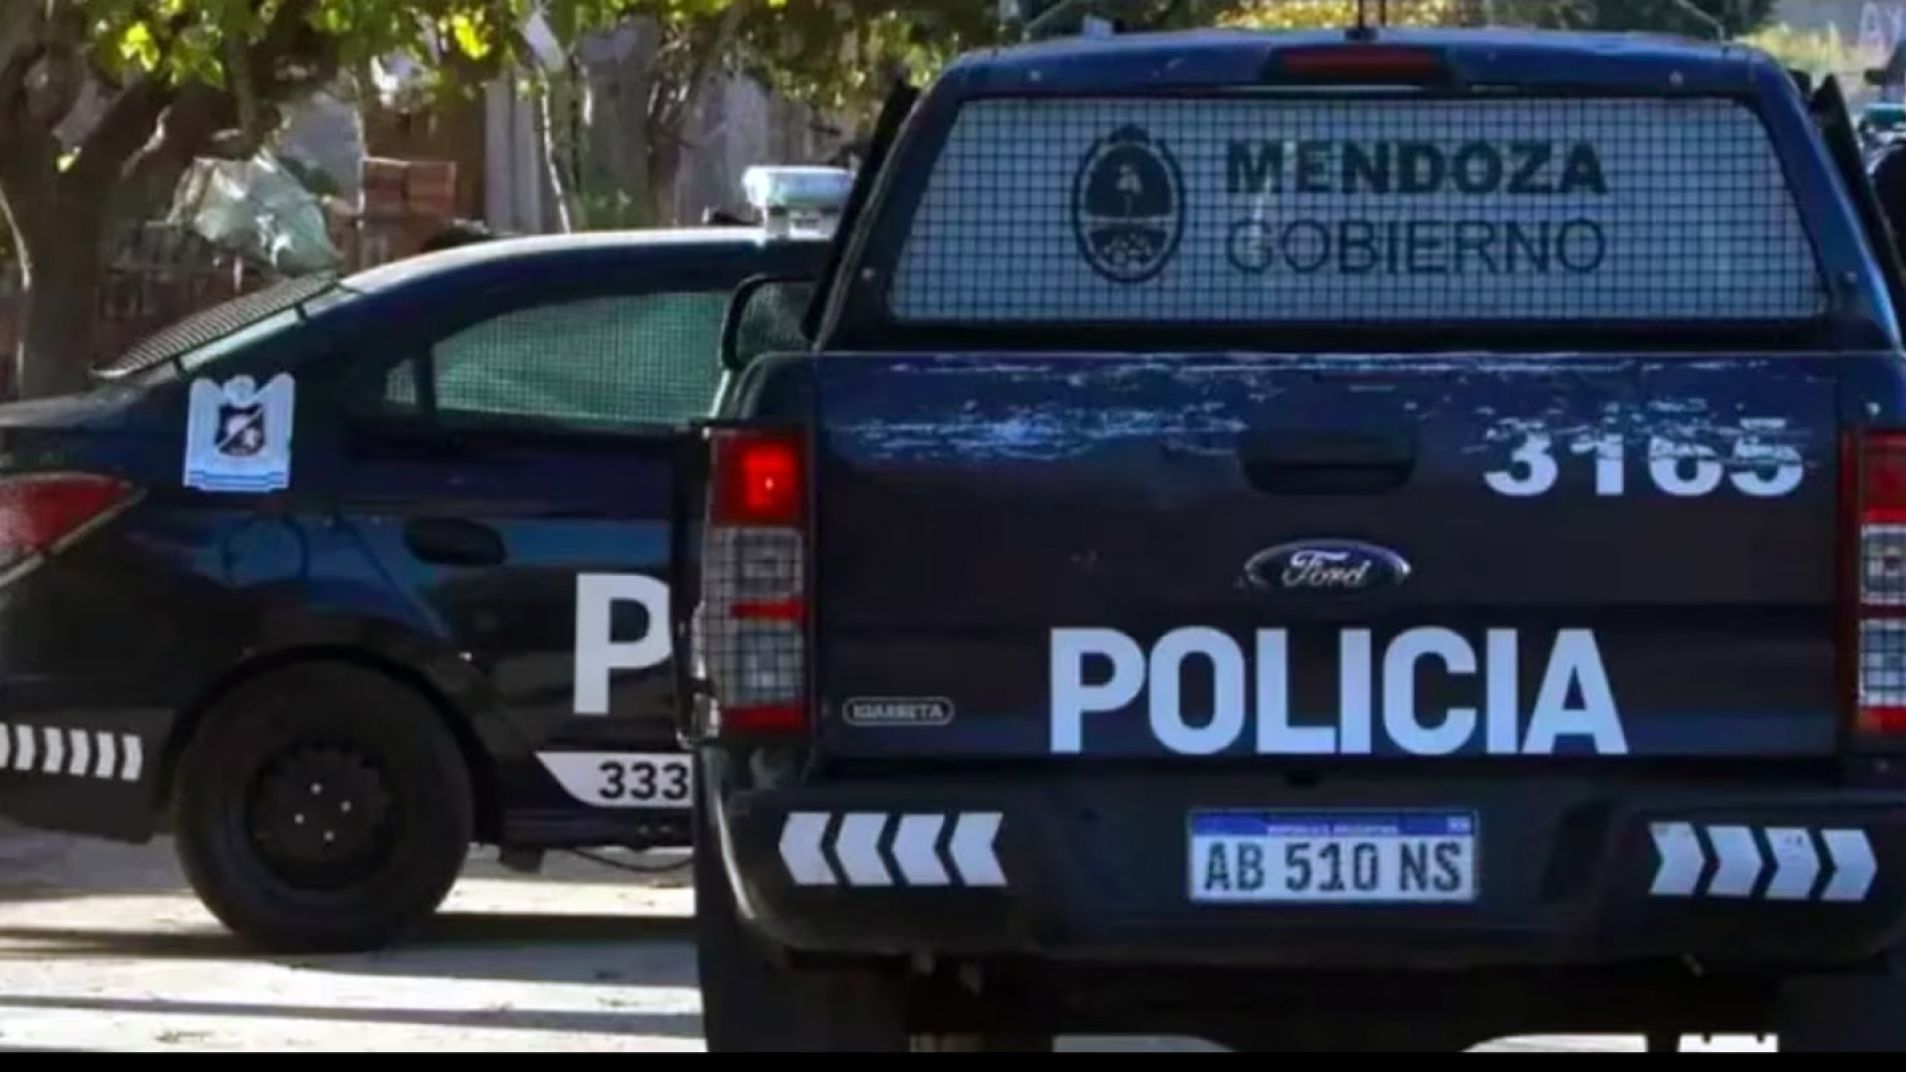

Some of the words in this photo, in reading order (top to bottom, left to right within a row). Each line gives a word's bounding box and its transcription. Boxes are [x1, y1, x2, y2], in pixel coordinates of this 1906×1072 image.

[1227, 139, 1609, 196] MENDOZA
[1227, 218, 1607, 274] GOBIERNO
[1484, 416, 1803, 496] 3165
[1281, 550, 1372, 588] Ford
[573, 573, 673, 715] P
[1050, 626, 1628, 755] POLICIA
[598, 761, 689, 801] 333
[1204, 843, 1264, 892] AB
[1285, 843, 1379, 892] 510
[1400, 842, 1462, 892] NS
